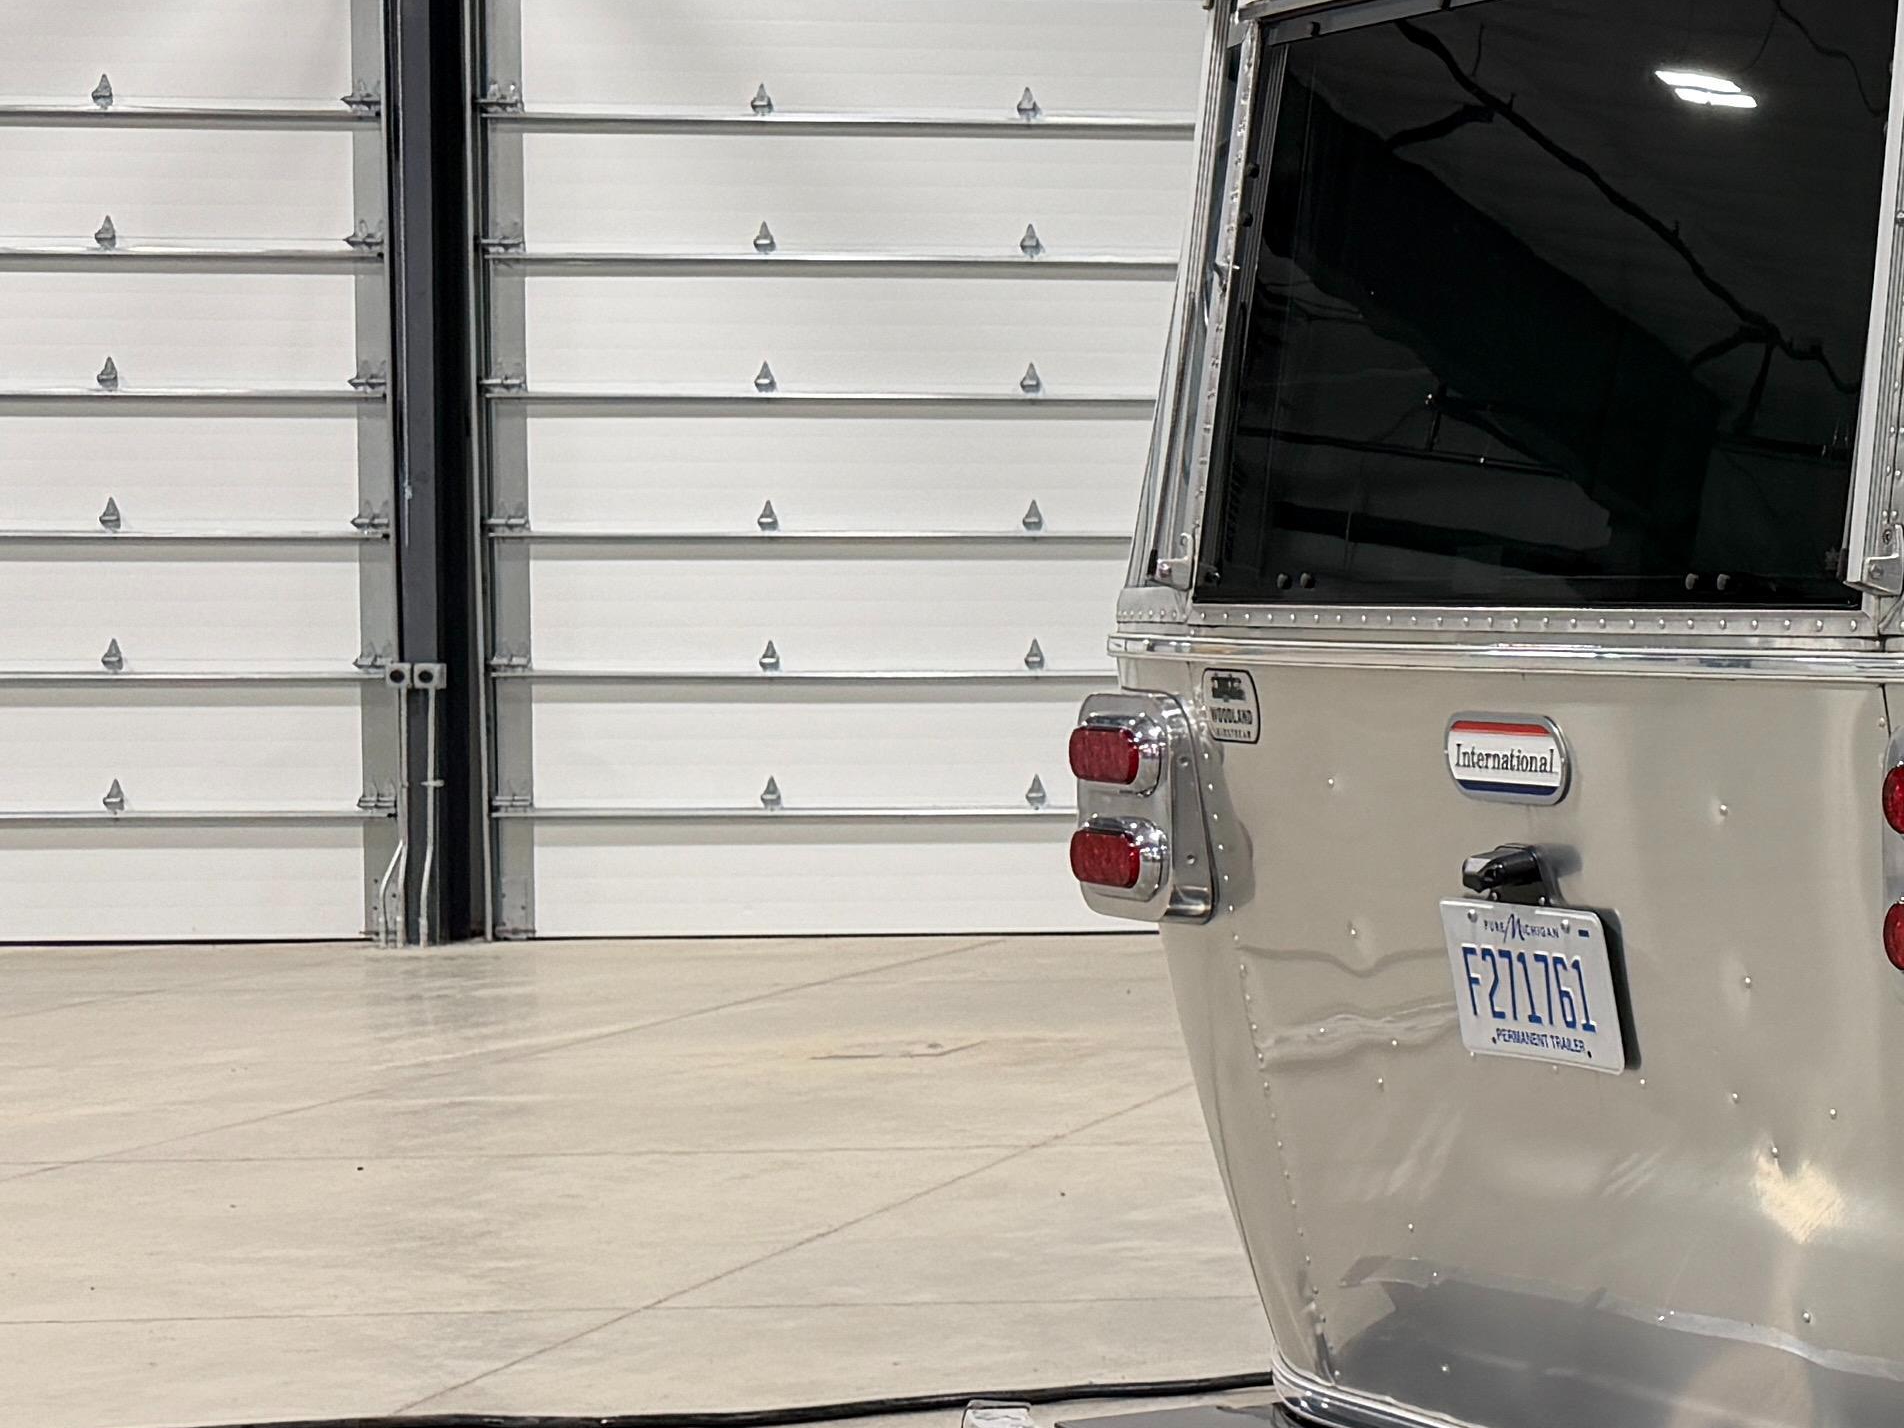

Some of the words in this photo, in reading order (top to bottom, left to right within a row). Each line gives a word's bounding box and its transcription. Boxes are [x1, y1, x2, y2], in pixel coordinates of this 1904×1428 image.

[1455, 743, 1555, 774] International
[1484, 919, 1505, 933] PURE
[1461, 945, 1597, 1033] F271761
[1496, 1028, 1549, 1049] PERMANENT
[1549, 1035, 1585, 1054] TRAILER
